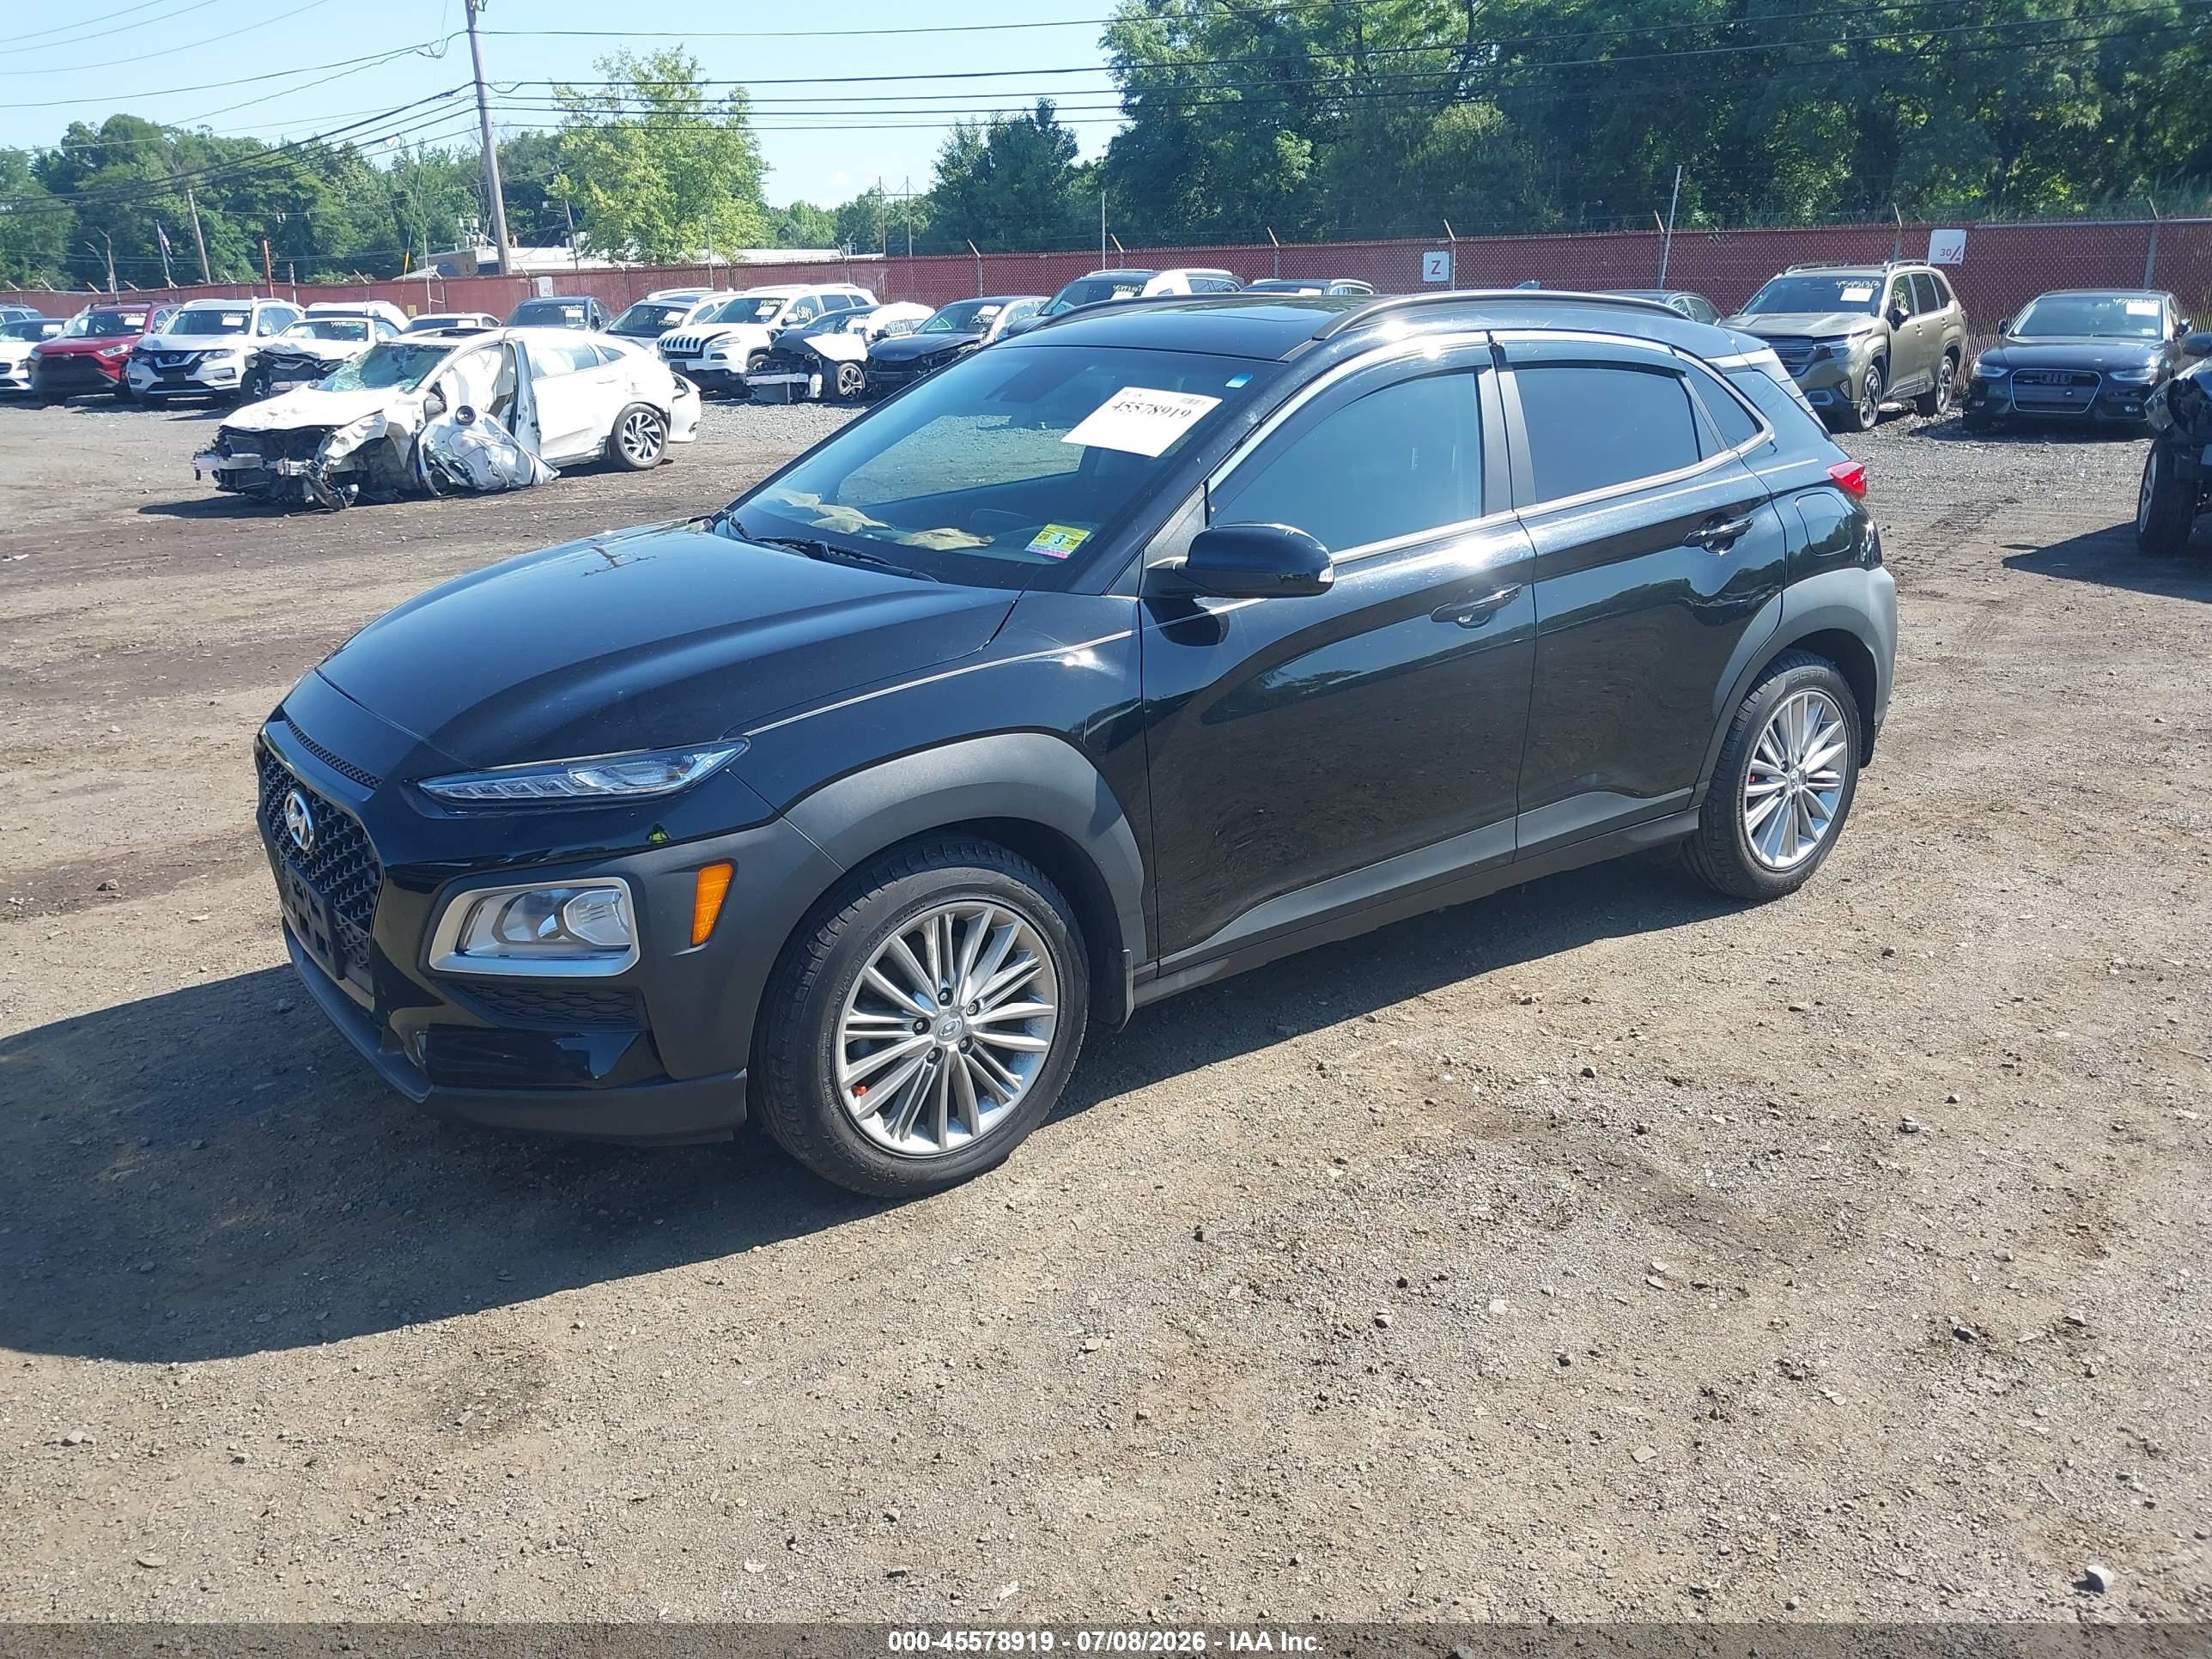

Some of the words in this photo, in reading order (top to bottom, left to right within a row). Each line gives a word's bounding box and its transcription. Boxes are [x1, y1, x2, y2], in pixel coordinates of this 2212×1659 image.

[1431, 259, 1442, 276] Z
[1112, 401, 1192, 419] 45578919
[1054, 534, 1066, 544] 3
